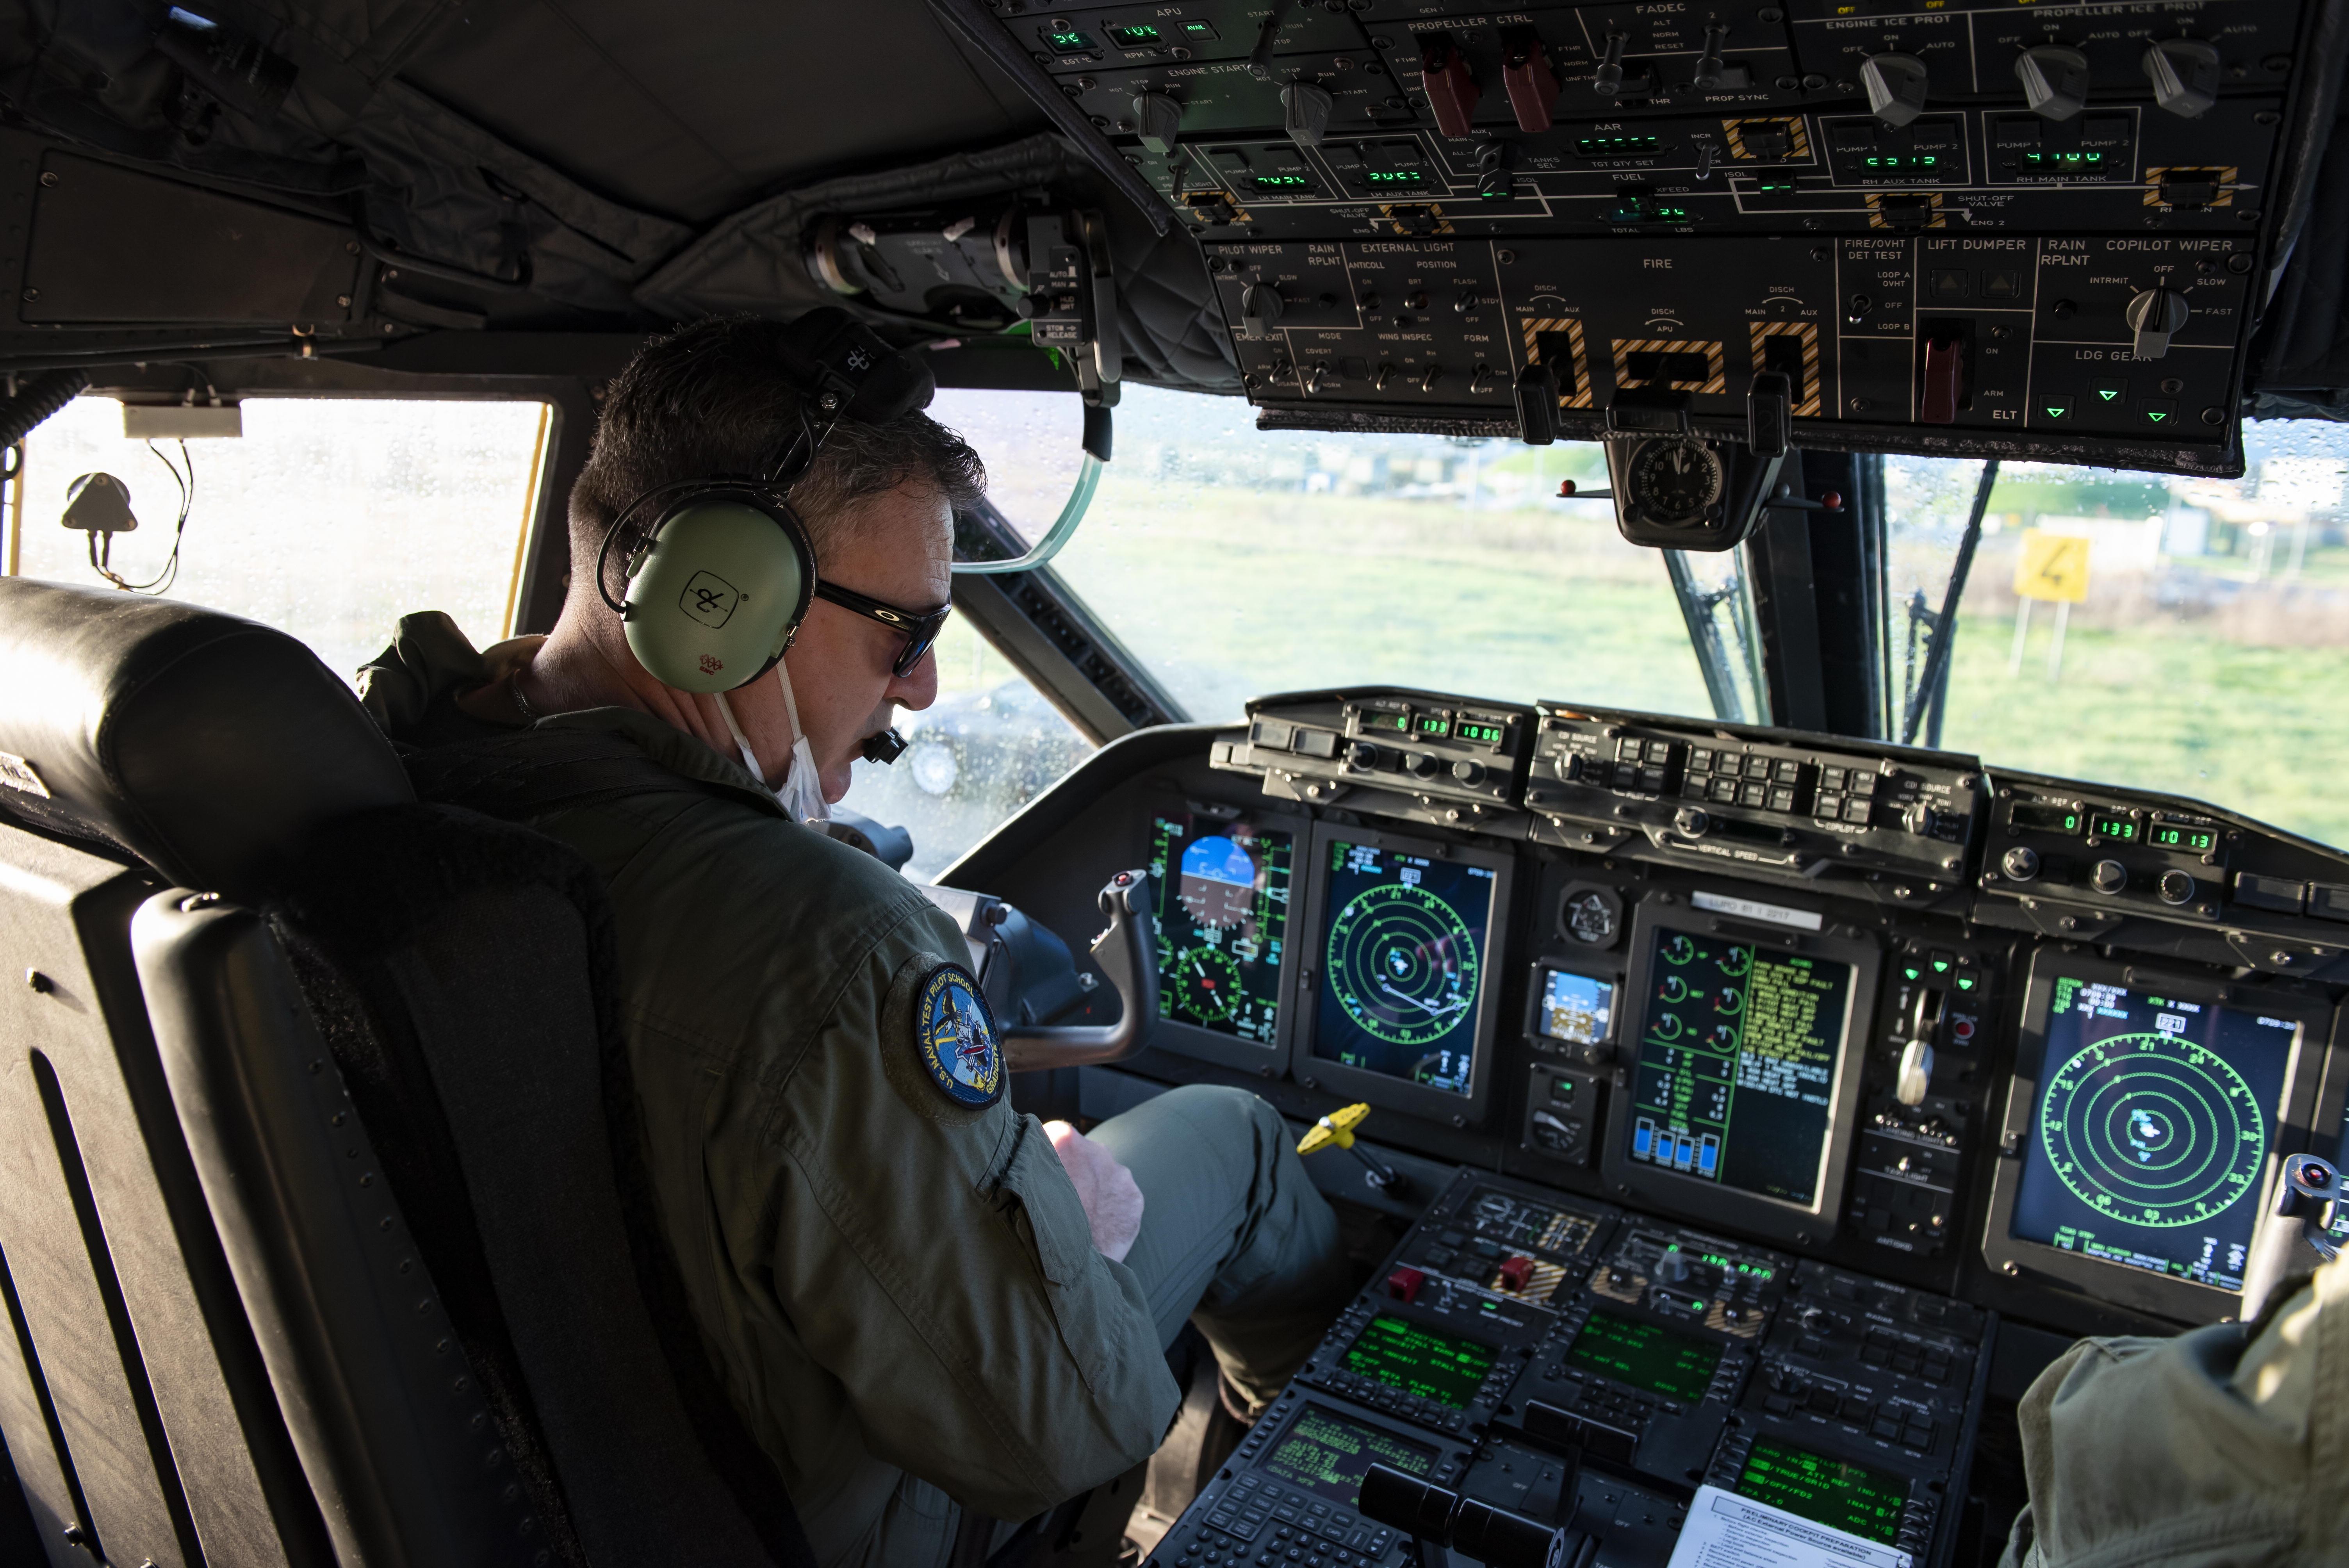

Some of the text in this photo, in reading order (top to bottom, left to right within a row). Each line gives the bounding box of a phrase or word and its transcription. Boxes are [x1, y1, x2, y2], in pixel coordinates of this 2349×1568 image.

[1157, 8, 1182, 17] APU
[1636, 4, 1685, 13] FADEC
[2034, 4, 2156, 17] PROPELLER ICE
[1408, 14, 1533, 31] PROPELLER CTRL
[1826, 19, 1878, 29] ENGINE
[1915, 15, 1951, 24] PROT
[1168, 64, 1248, 77] ENGINE START
[1309, 244, 1335, 254] RAIN
[1362, 243, 1454, 253] EXTERNAL LIGHT
[1845, 240, 1905, 248] FIRE/OVHT
[1928, 240, 2026, 249] LIFT DUMPER
[2048, 241, 2085, 250] RAIN
[2106, 240, 2232, 251] COPILOT WIPER
[1219, 245, 1283, 255] PILOT WIPER
[1308, 257, 1341, 266] RPLNT
[1643, 259, 1672, 269] FIRE
[2041, 255, 2090, 265] RPLNT
[2075, 351, 2103, 360] LDG
[1993, 411, 2017, 419] ELT
[1424, 720, 1447, 733] 133
[2103, 821, 2132, 837] 133
[929, 974, 947, 997] PILOT
[948, 973, 974, 998] SCHOOL
[922, 996, 933, 1026] TEST
[923, 1028, 938, 1069] NAVAL
[986, 1044, 999, 1094] GRADUATE
[1741, 1508, 1871, 1555] PRELIMINARY COCKPIT PREPARATION
